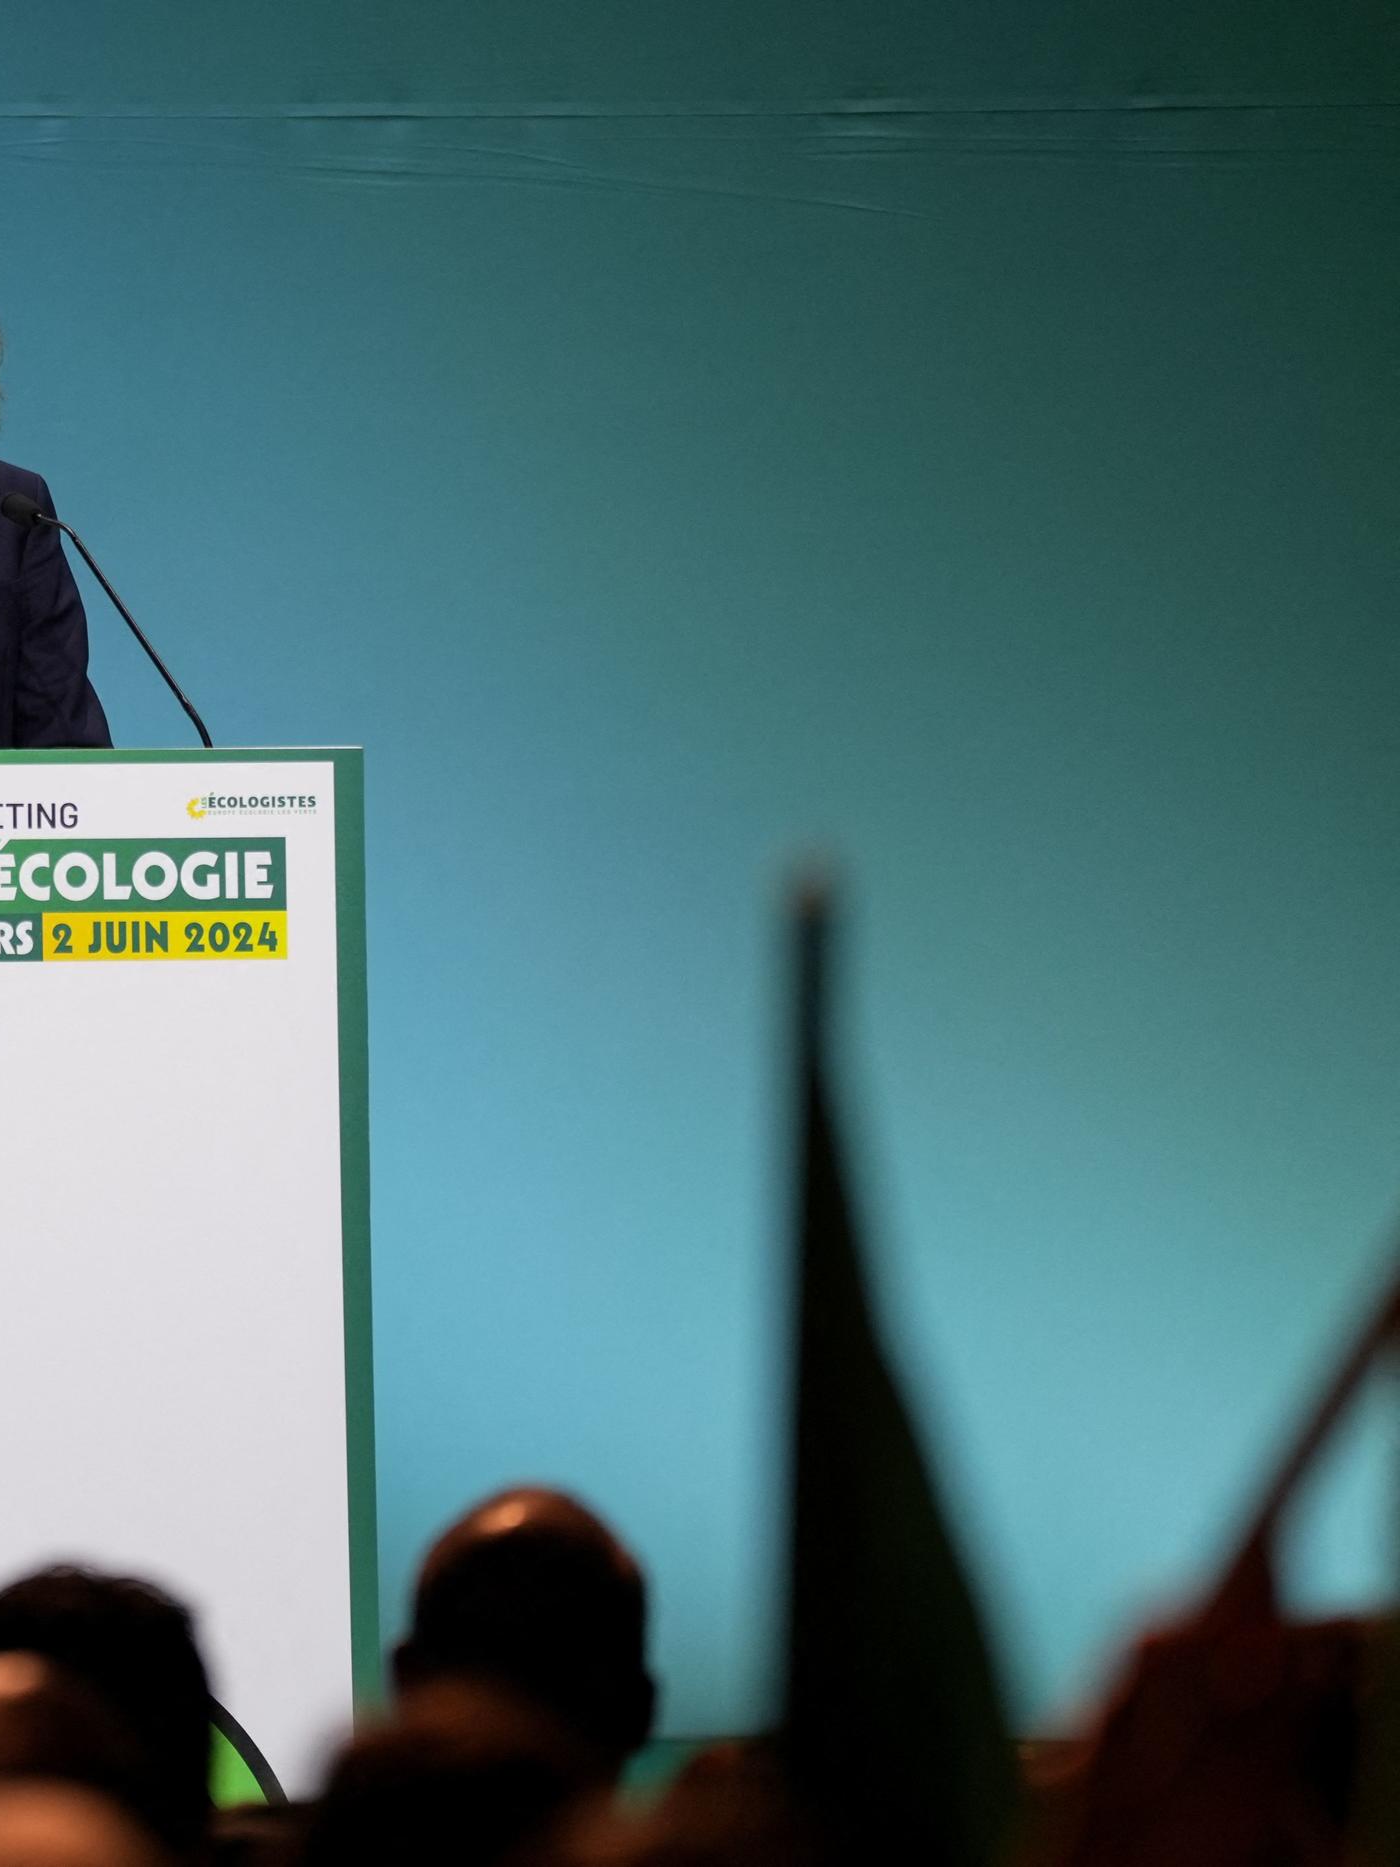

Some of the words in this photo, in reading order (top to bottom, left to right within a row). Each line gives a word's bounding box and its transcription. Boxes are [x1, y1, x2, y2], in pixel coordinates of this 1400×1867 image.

[208, 792, 316, 808] ÉCOLOGISTES
[51, 923, 73, 954] 2
[88, 921, 169, 954] JUIN
[184, 921, 278, 953] 2024
